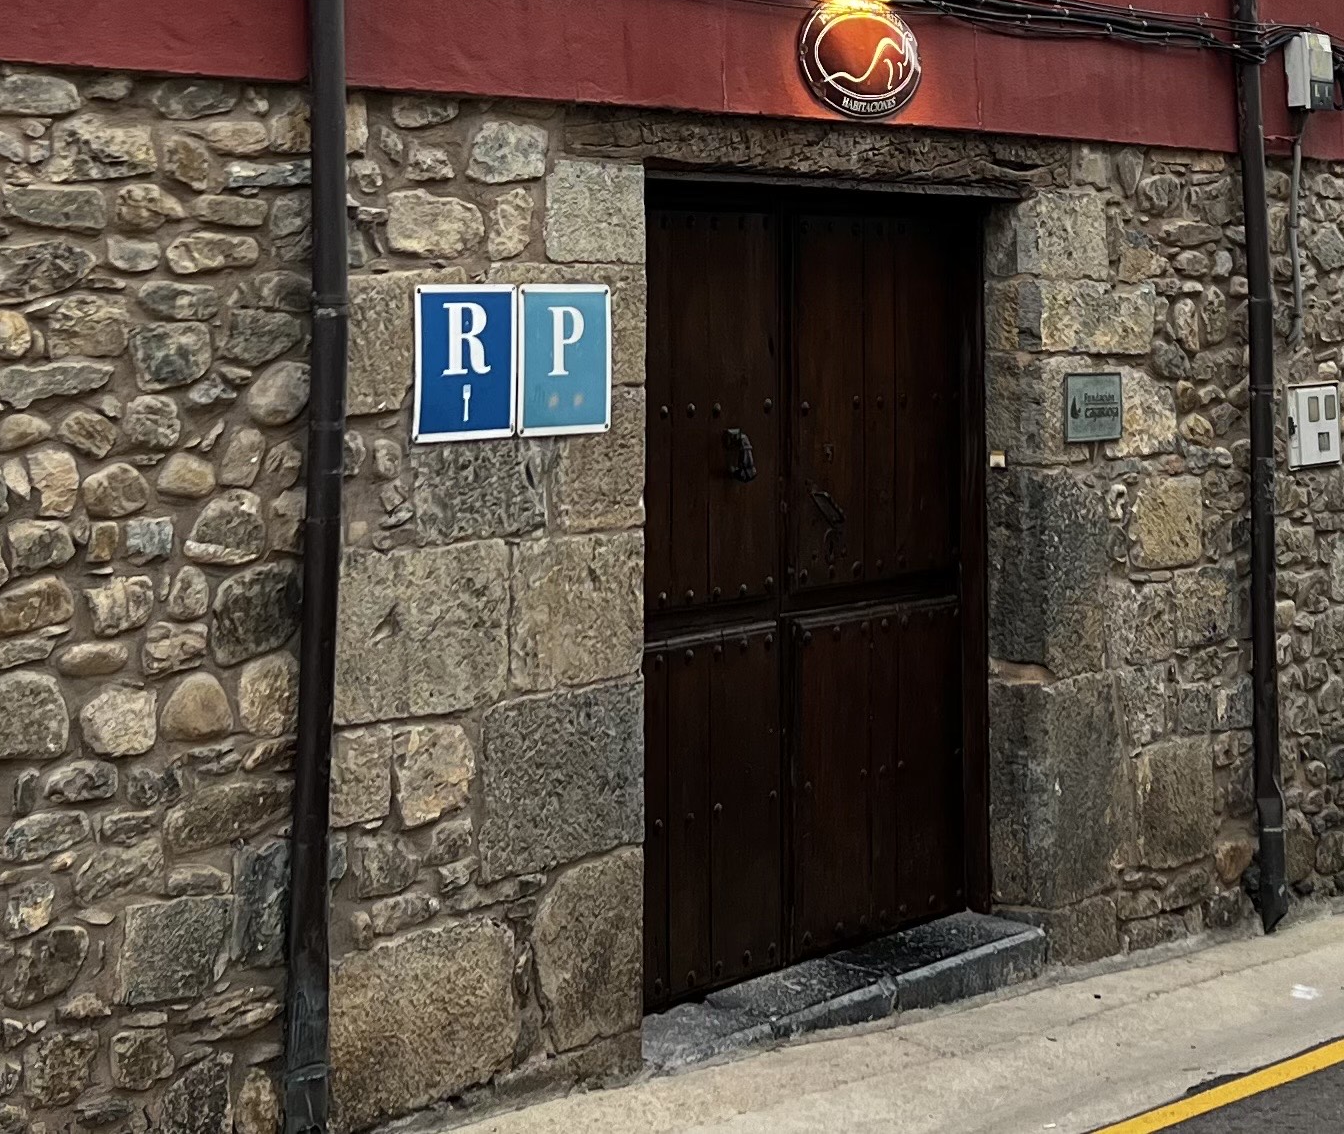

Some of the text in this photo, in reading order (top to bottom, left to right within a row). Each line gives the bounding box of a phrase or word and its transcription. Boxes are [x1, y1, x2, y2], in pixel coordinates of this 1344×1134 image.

[842, 96, 896, 113] HABITACIONES
[441, 302, 492, 376] R
[547, 306, 585, 376] P
